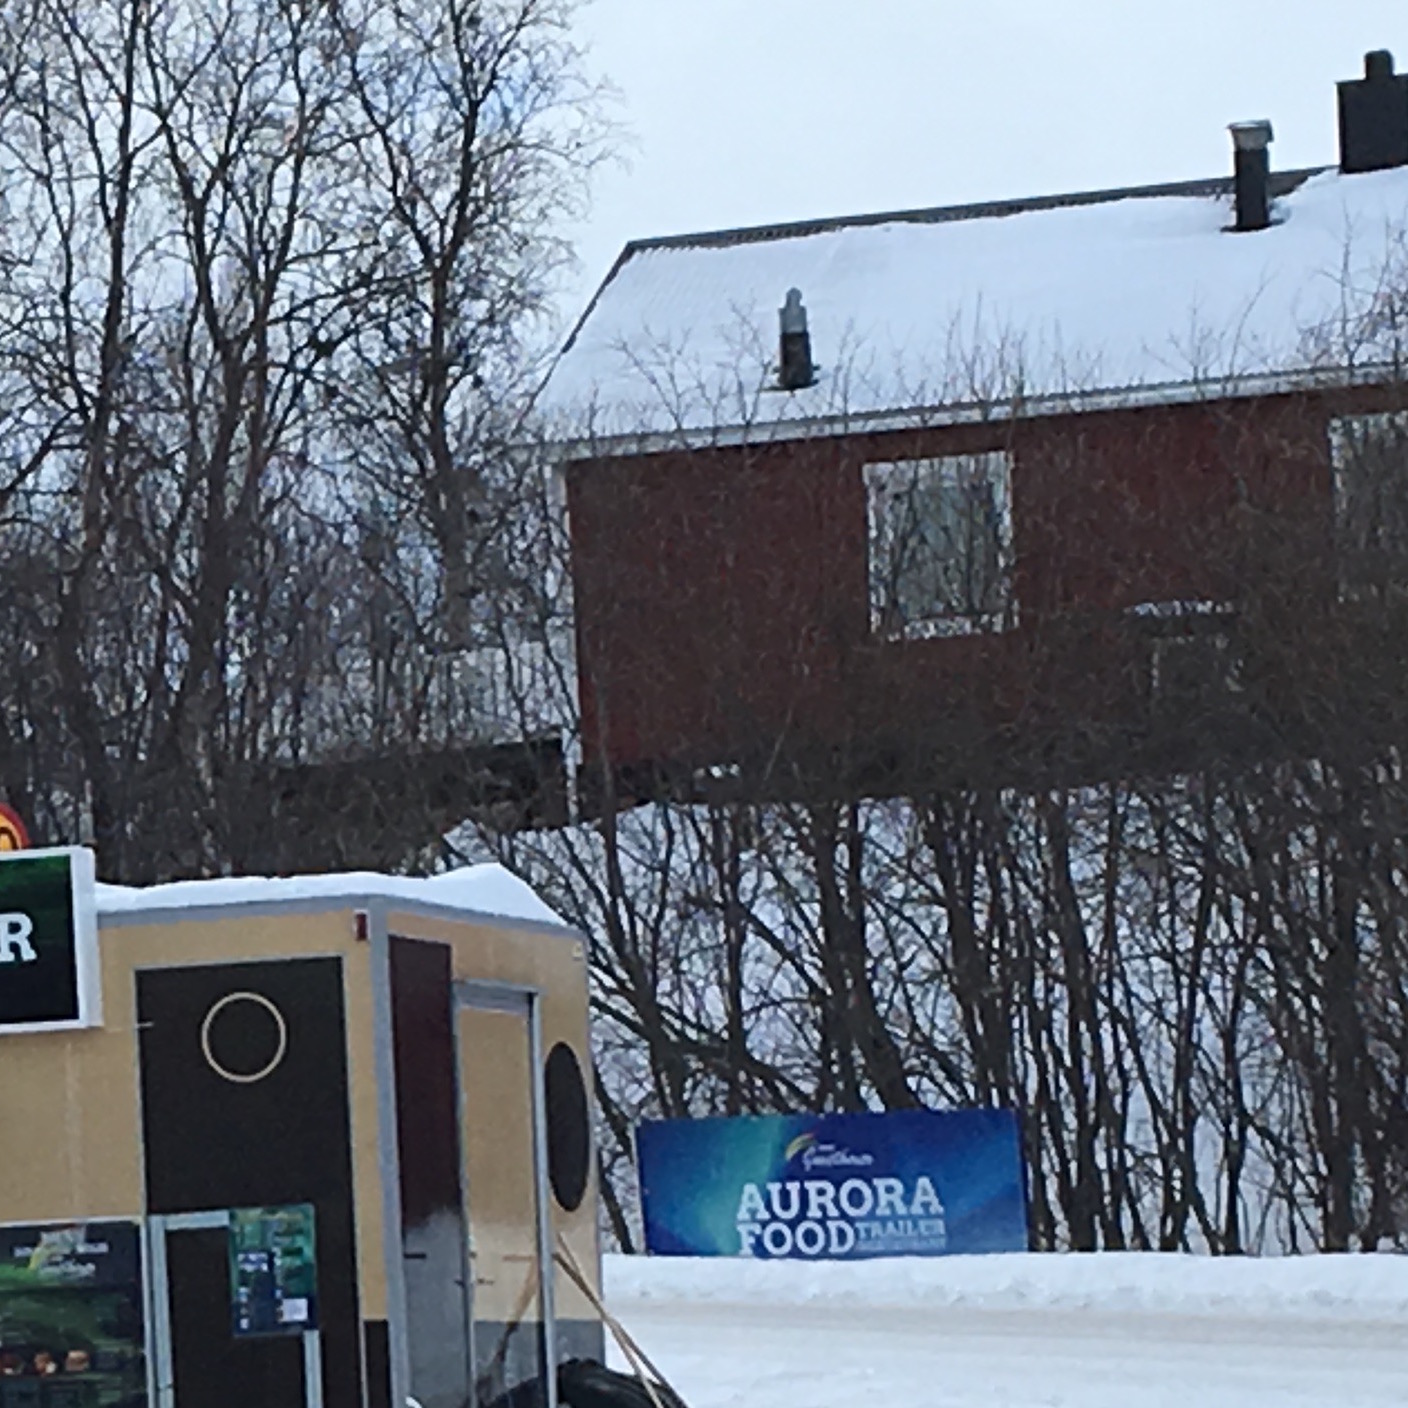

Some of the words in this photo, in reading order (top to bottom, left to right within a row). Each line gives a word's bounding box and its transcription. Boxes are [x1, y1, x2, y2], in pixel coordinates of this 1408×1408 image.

[736, 1175, 945, 1220] AURORA
[736, 1219, 856, 1256] FOOD
[854, 1218, 946, 1240] TRAILER
